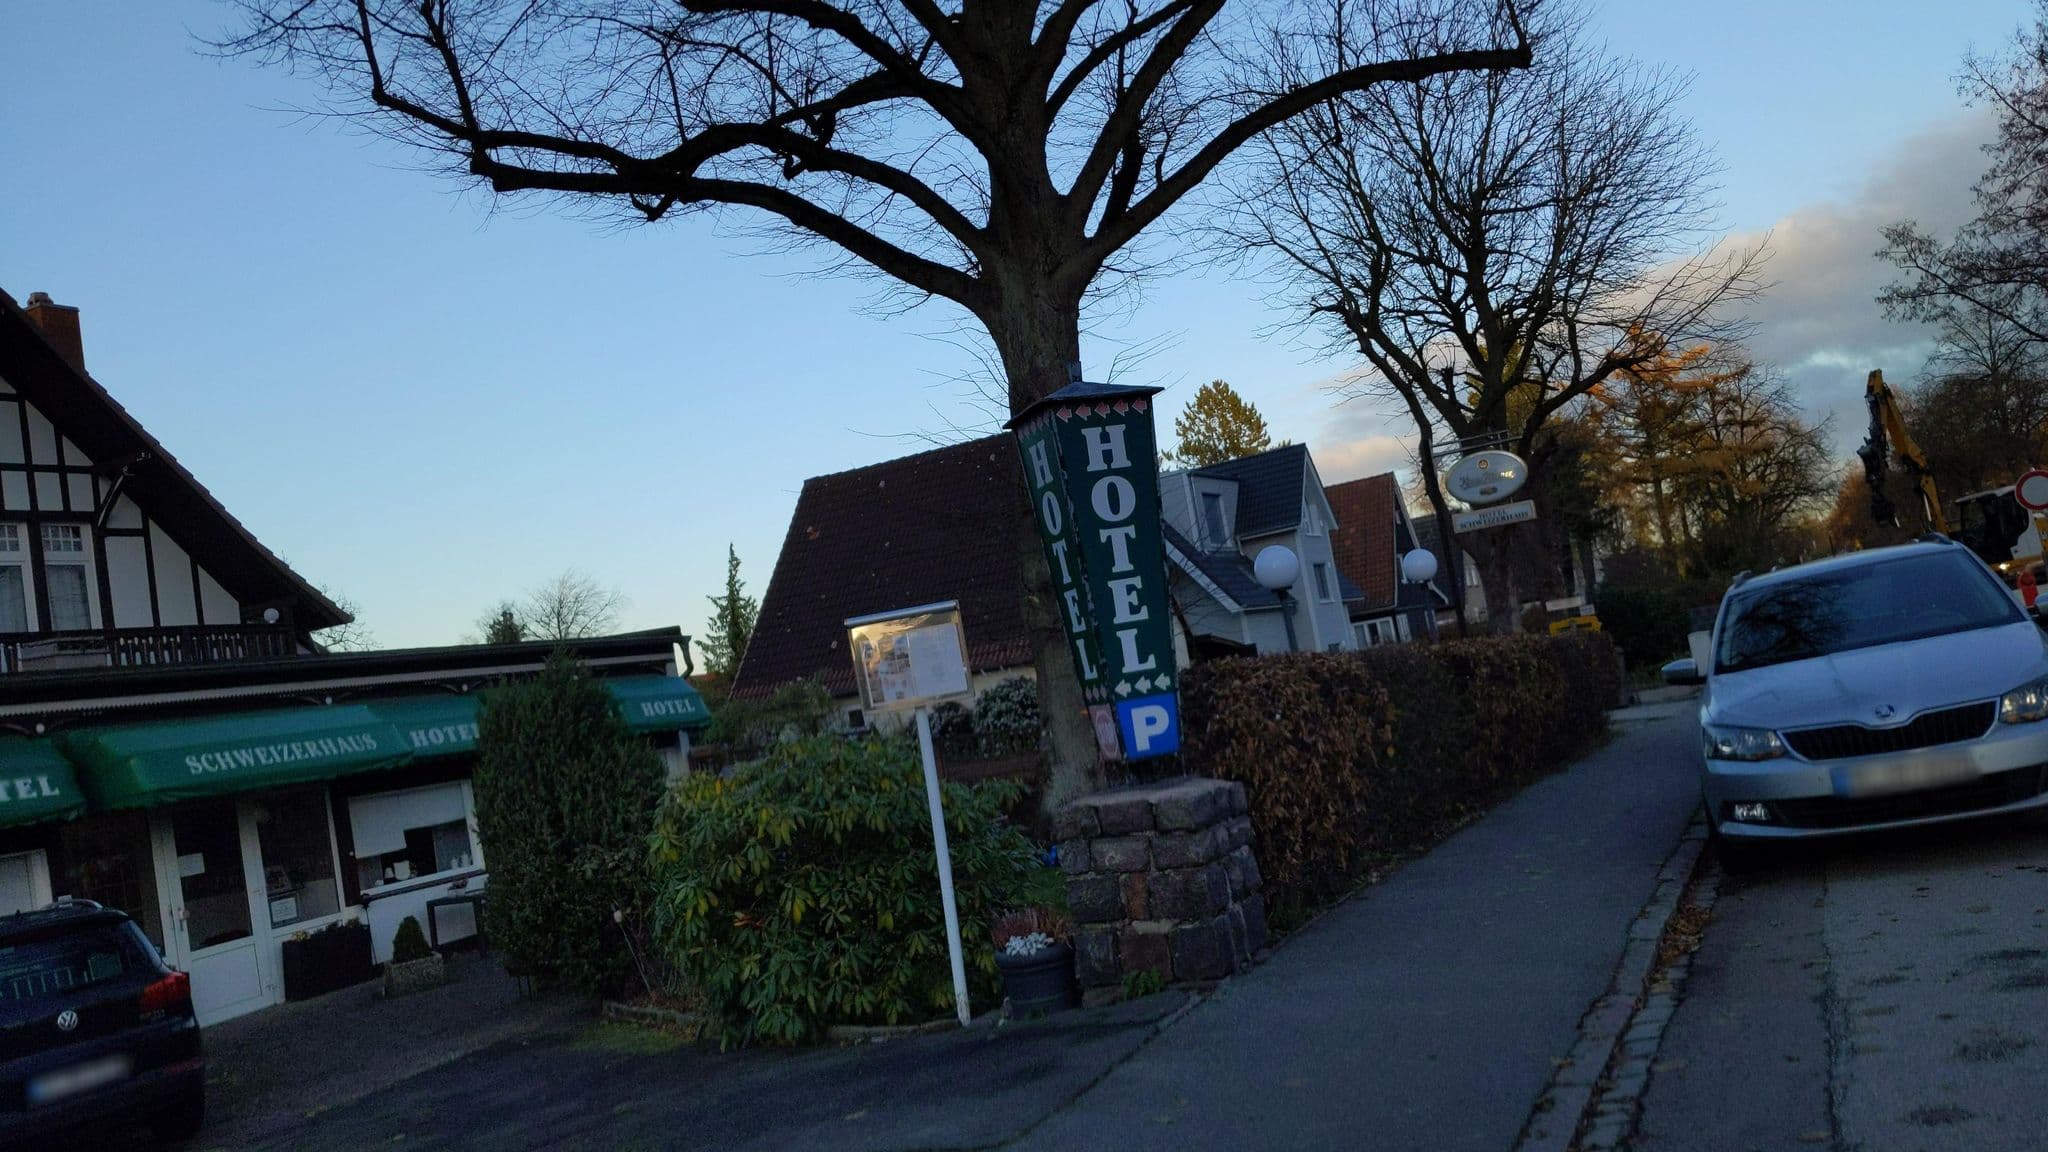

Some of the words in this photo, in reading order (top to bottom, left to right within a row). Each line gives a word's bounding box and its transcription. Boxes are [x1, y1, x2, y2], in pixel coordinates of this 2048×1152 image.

[1027, 438, 1098, 681] HOTEL
[1081, 424, 1156, 673] HOTEL
[640, 699, 696, 717] HOTEL
[1131, 705, 1170, 752] P
[184, 733, 378, 775] SCHWEIZERHAUS
